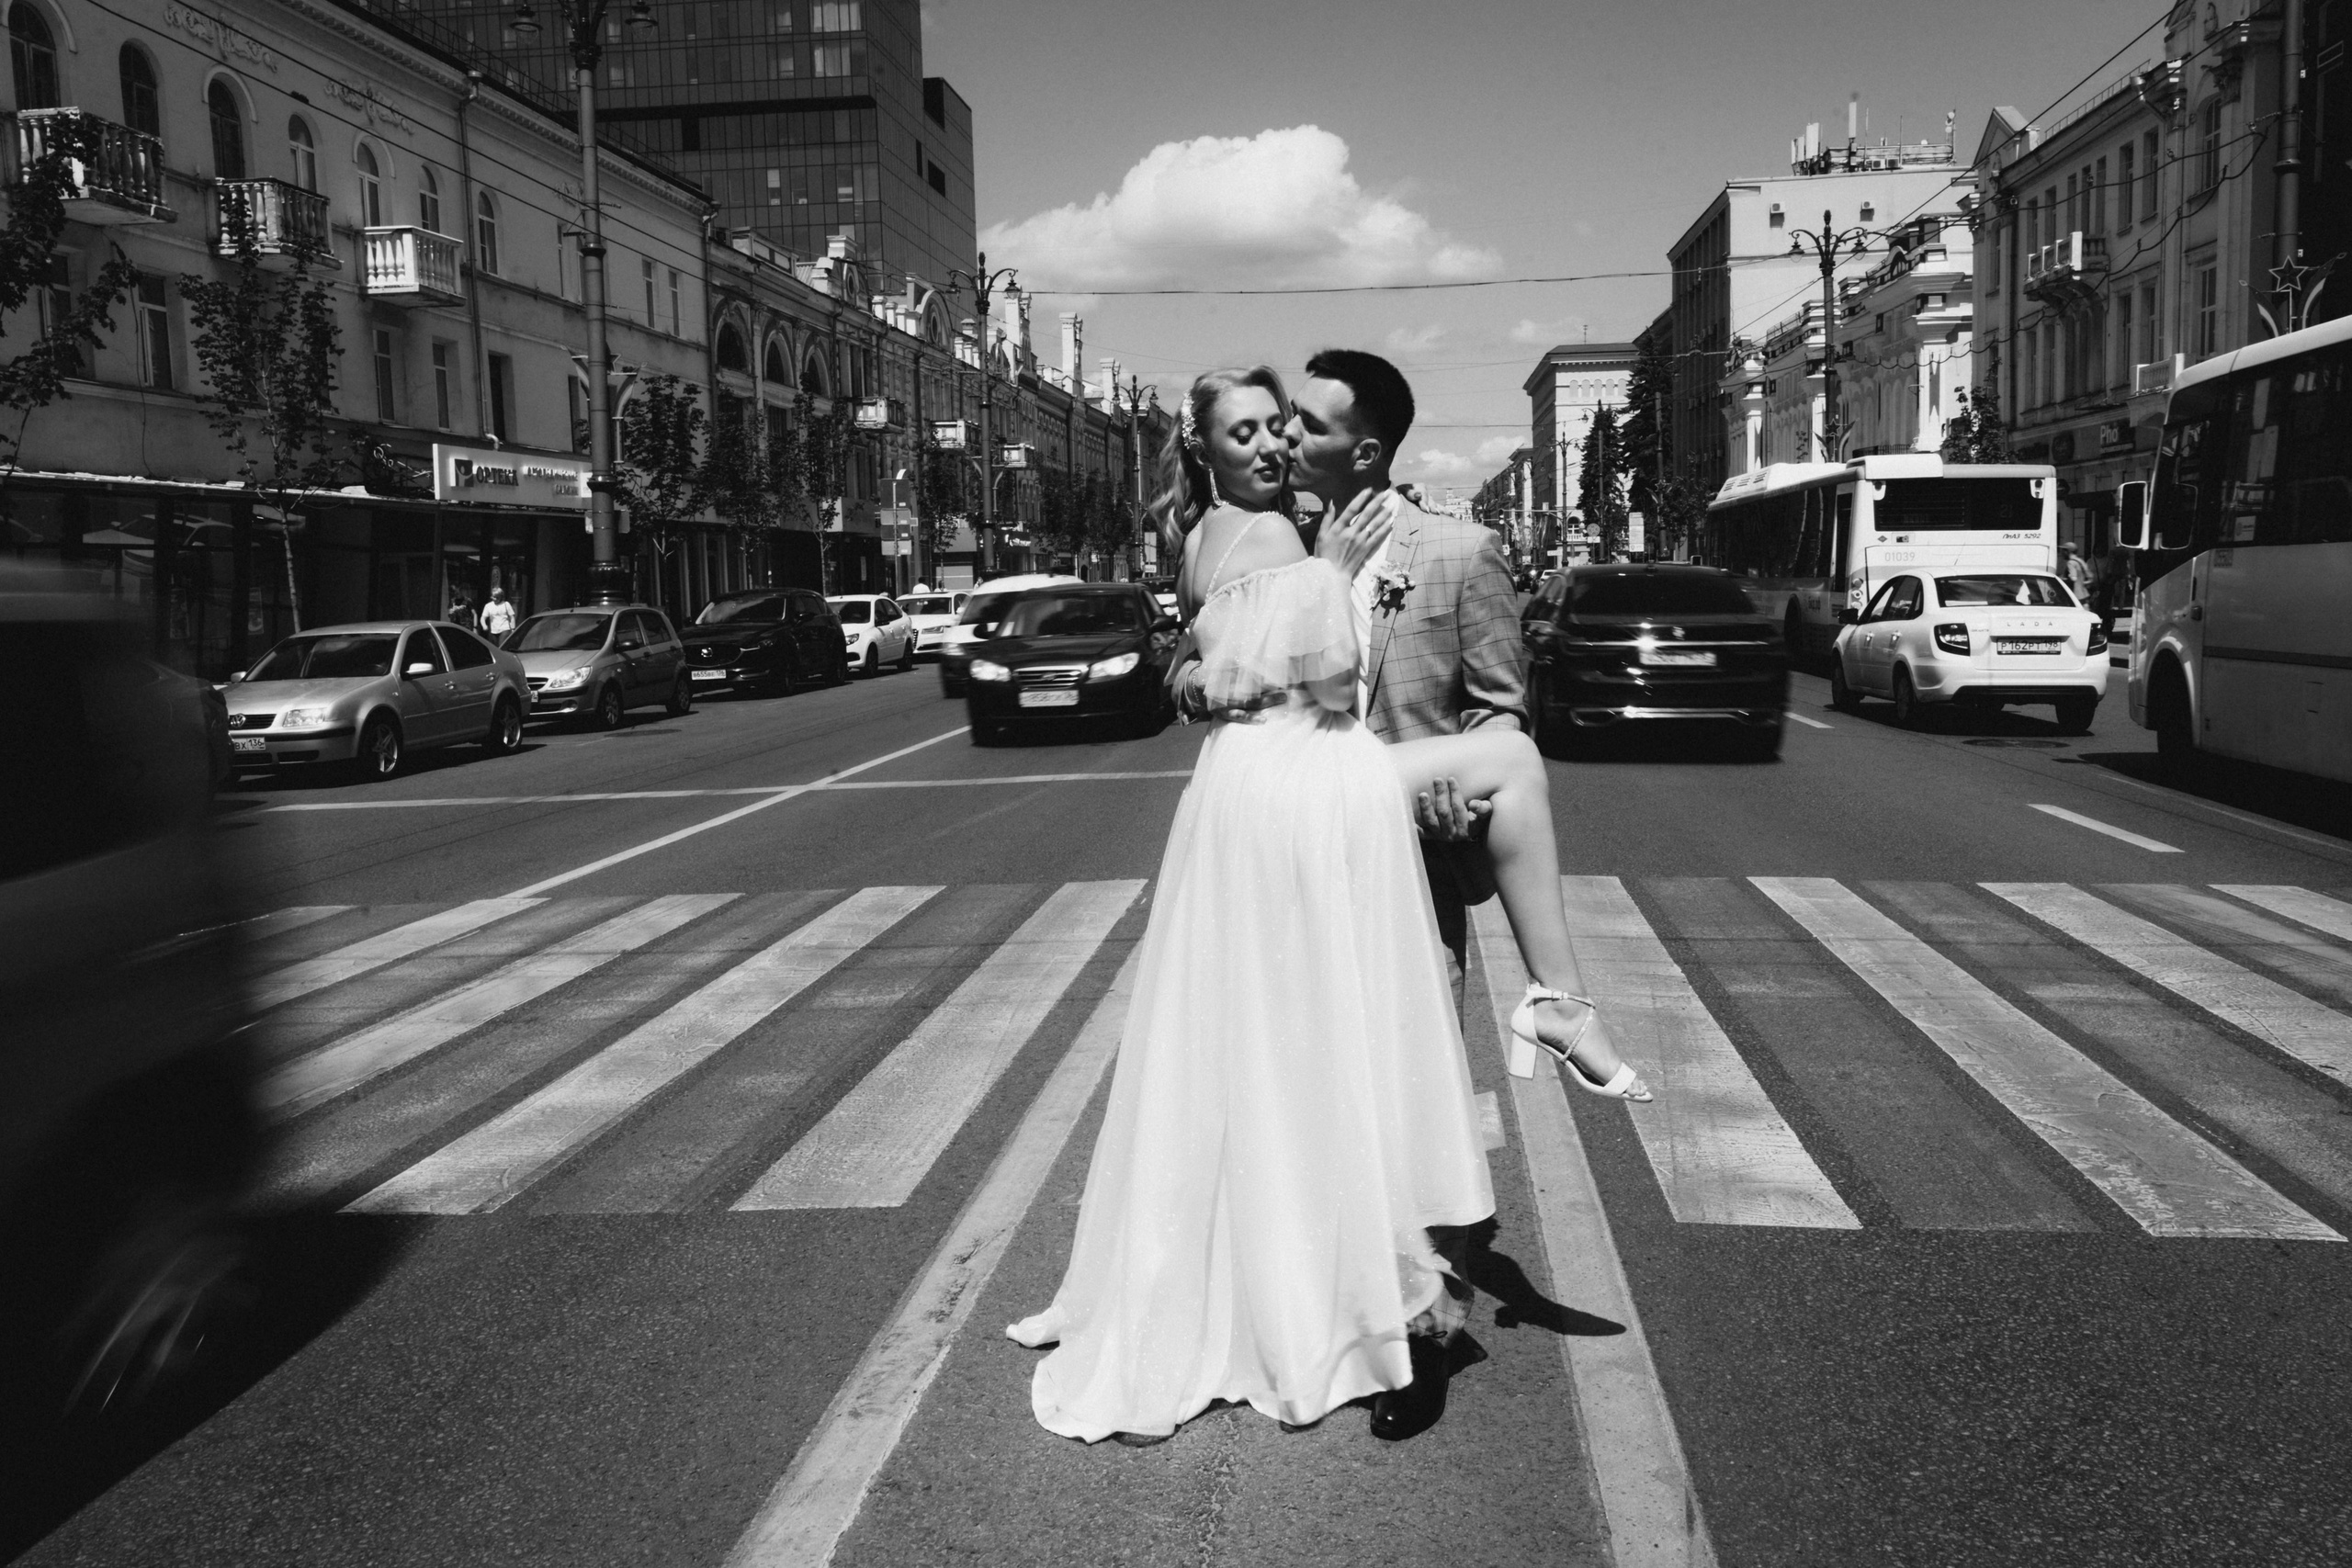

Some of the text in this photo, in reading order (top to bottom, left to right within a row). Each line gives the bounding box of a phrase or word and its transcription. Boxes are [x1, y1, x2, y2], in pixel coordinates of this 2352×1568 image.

[476, 466, 519, 486] ОРТЕКА
[1884, 551, 1916, 562] 01039
[248, 739, 263, 747] 136
